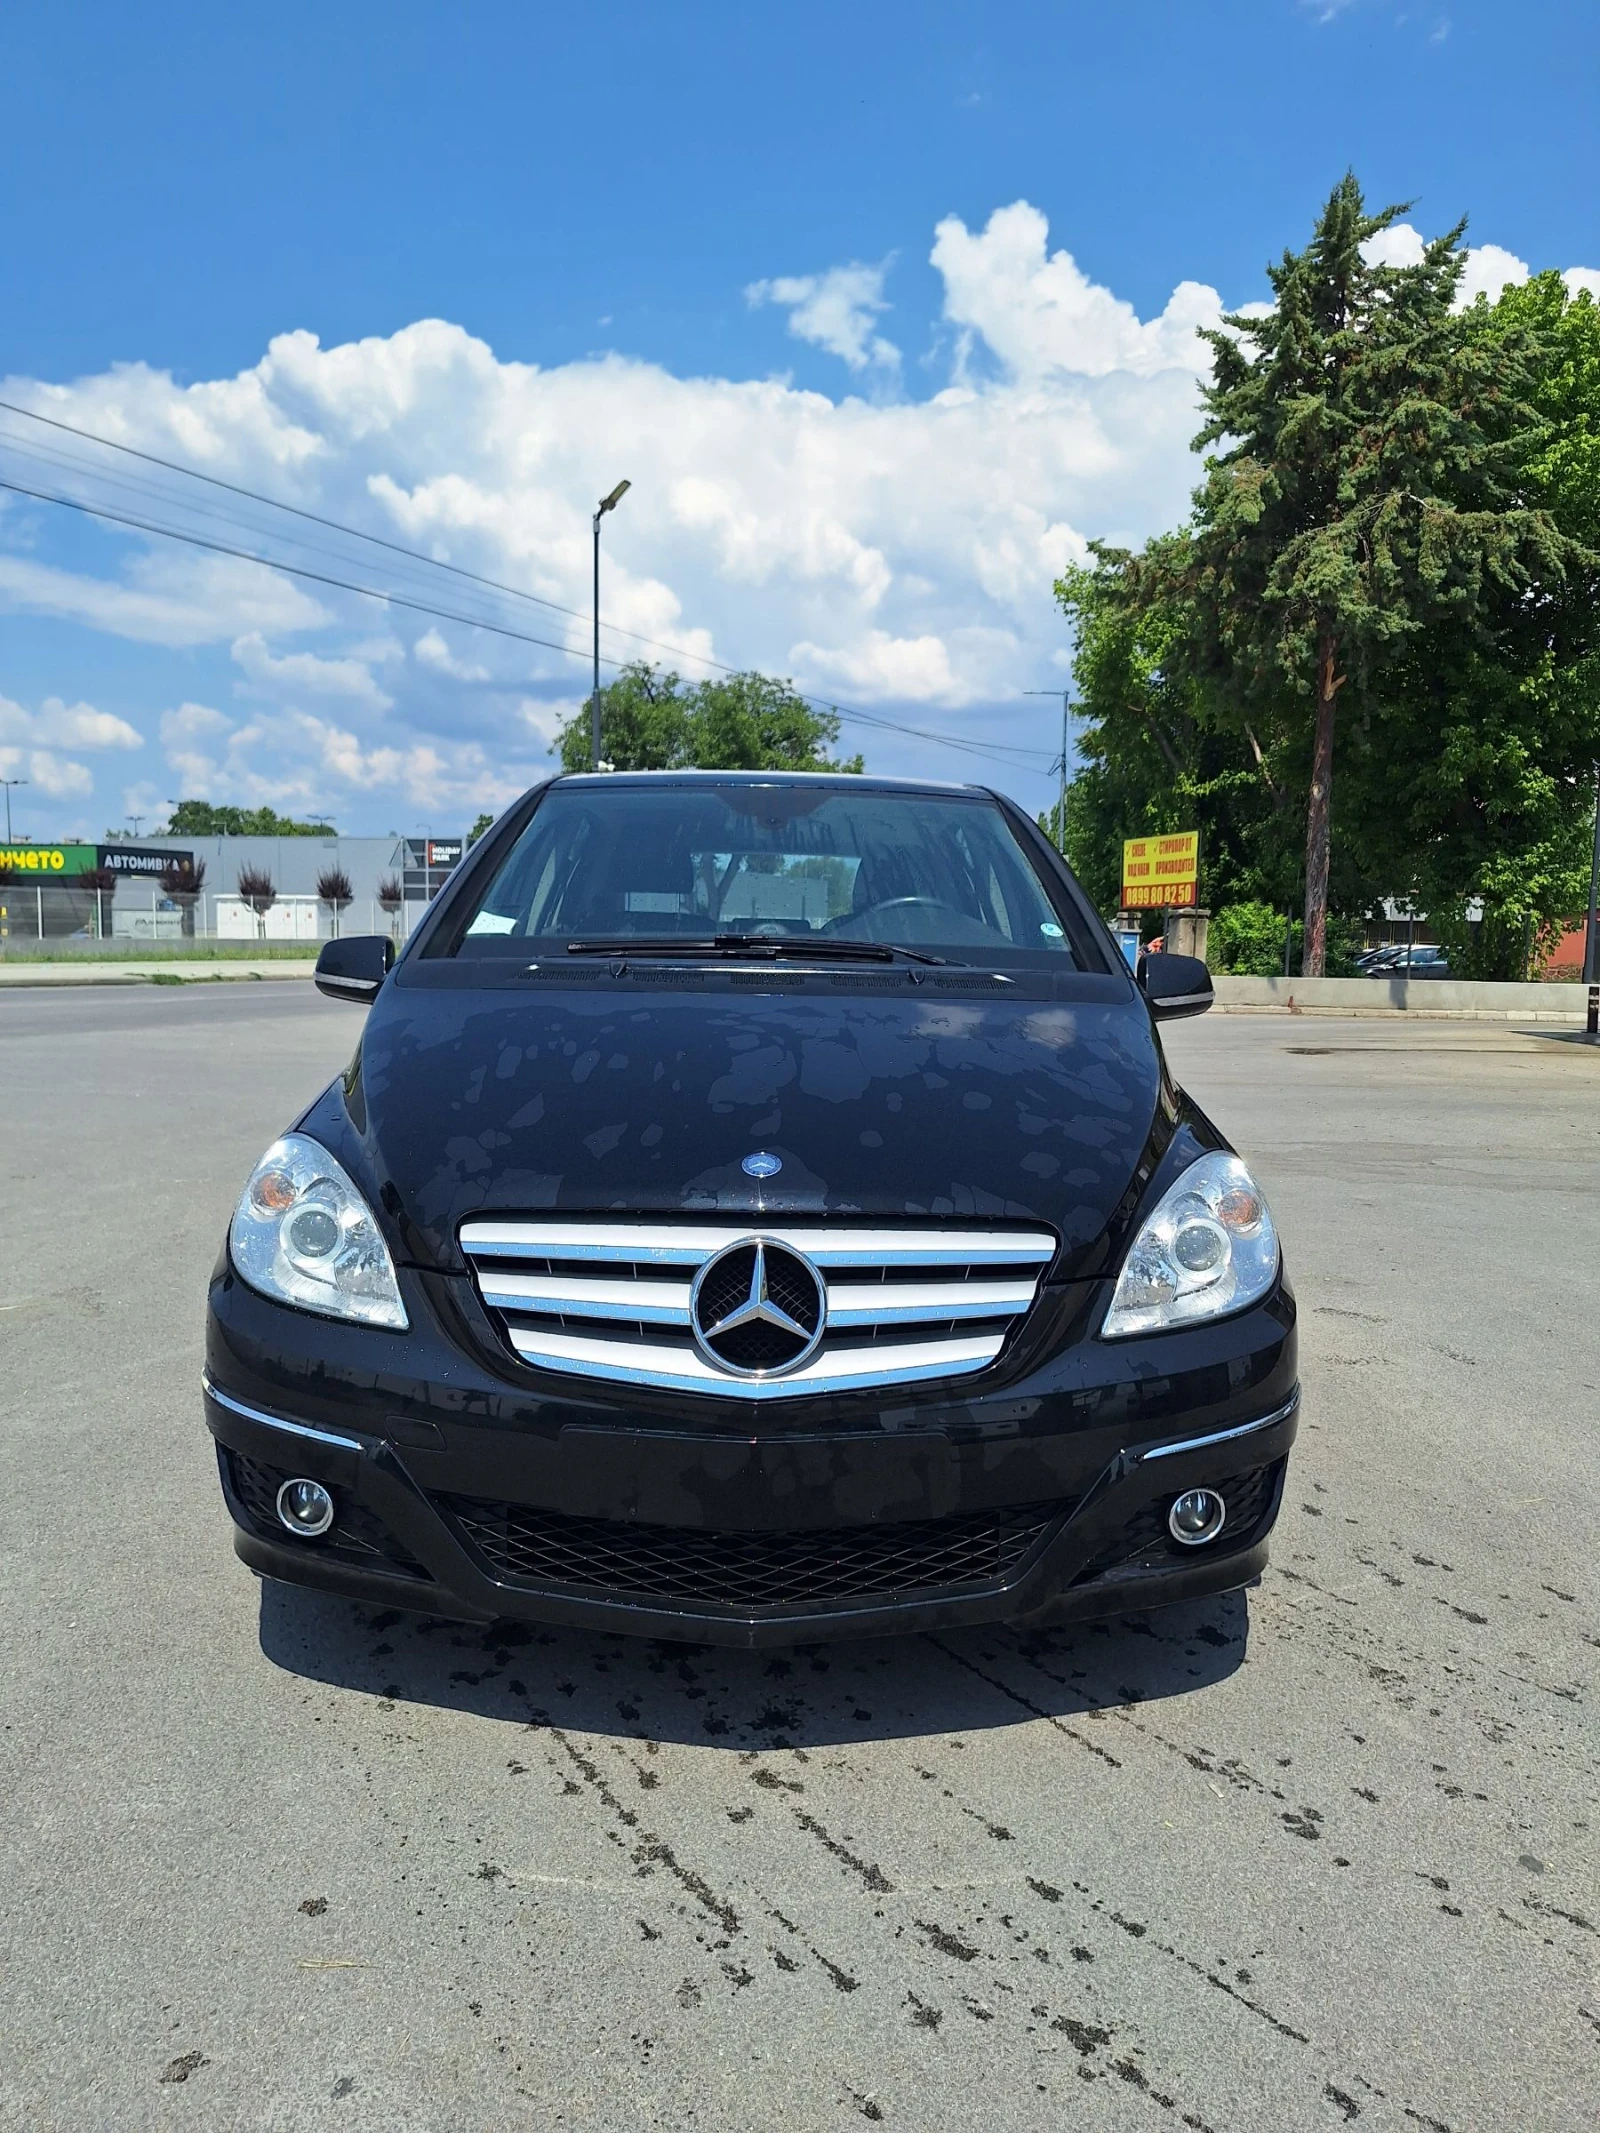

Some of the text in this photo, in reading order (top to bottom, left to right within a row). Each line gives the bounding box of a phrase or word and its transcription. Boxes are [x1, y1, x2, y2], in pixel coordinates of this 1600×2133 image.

[432, 846, 460, 854] HOLIDAY
[104, 854, 180, 872] АВТОМИВКА
[1126, 884, 1191, 905] 0899 80 82 50
